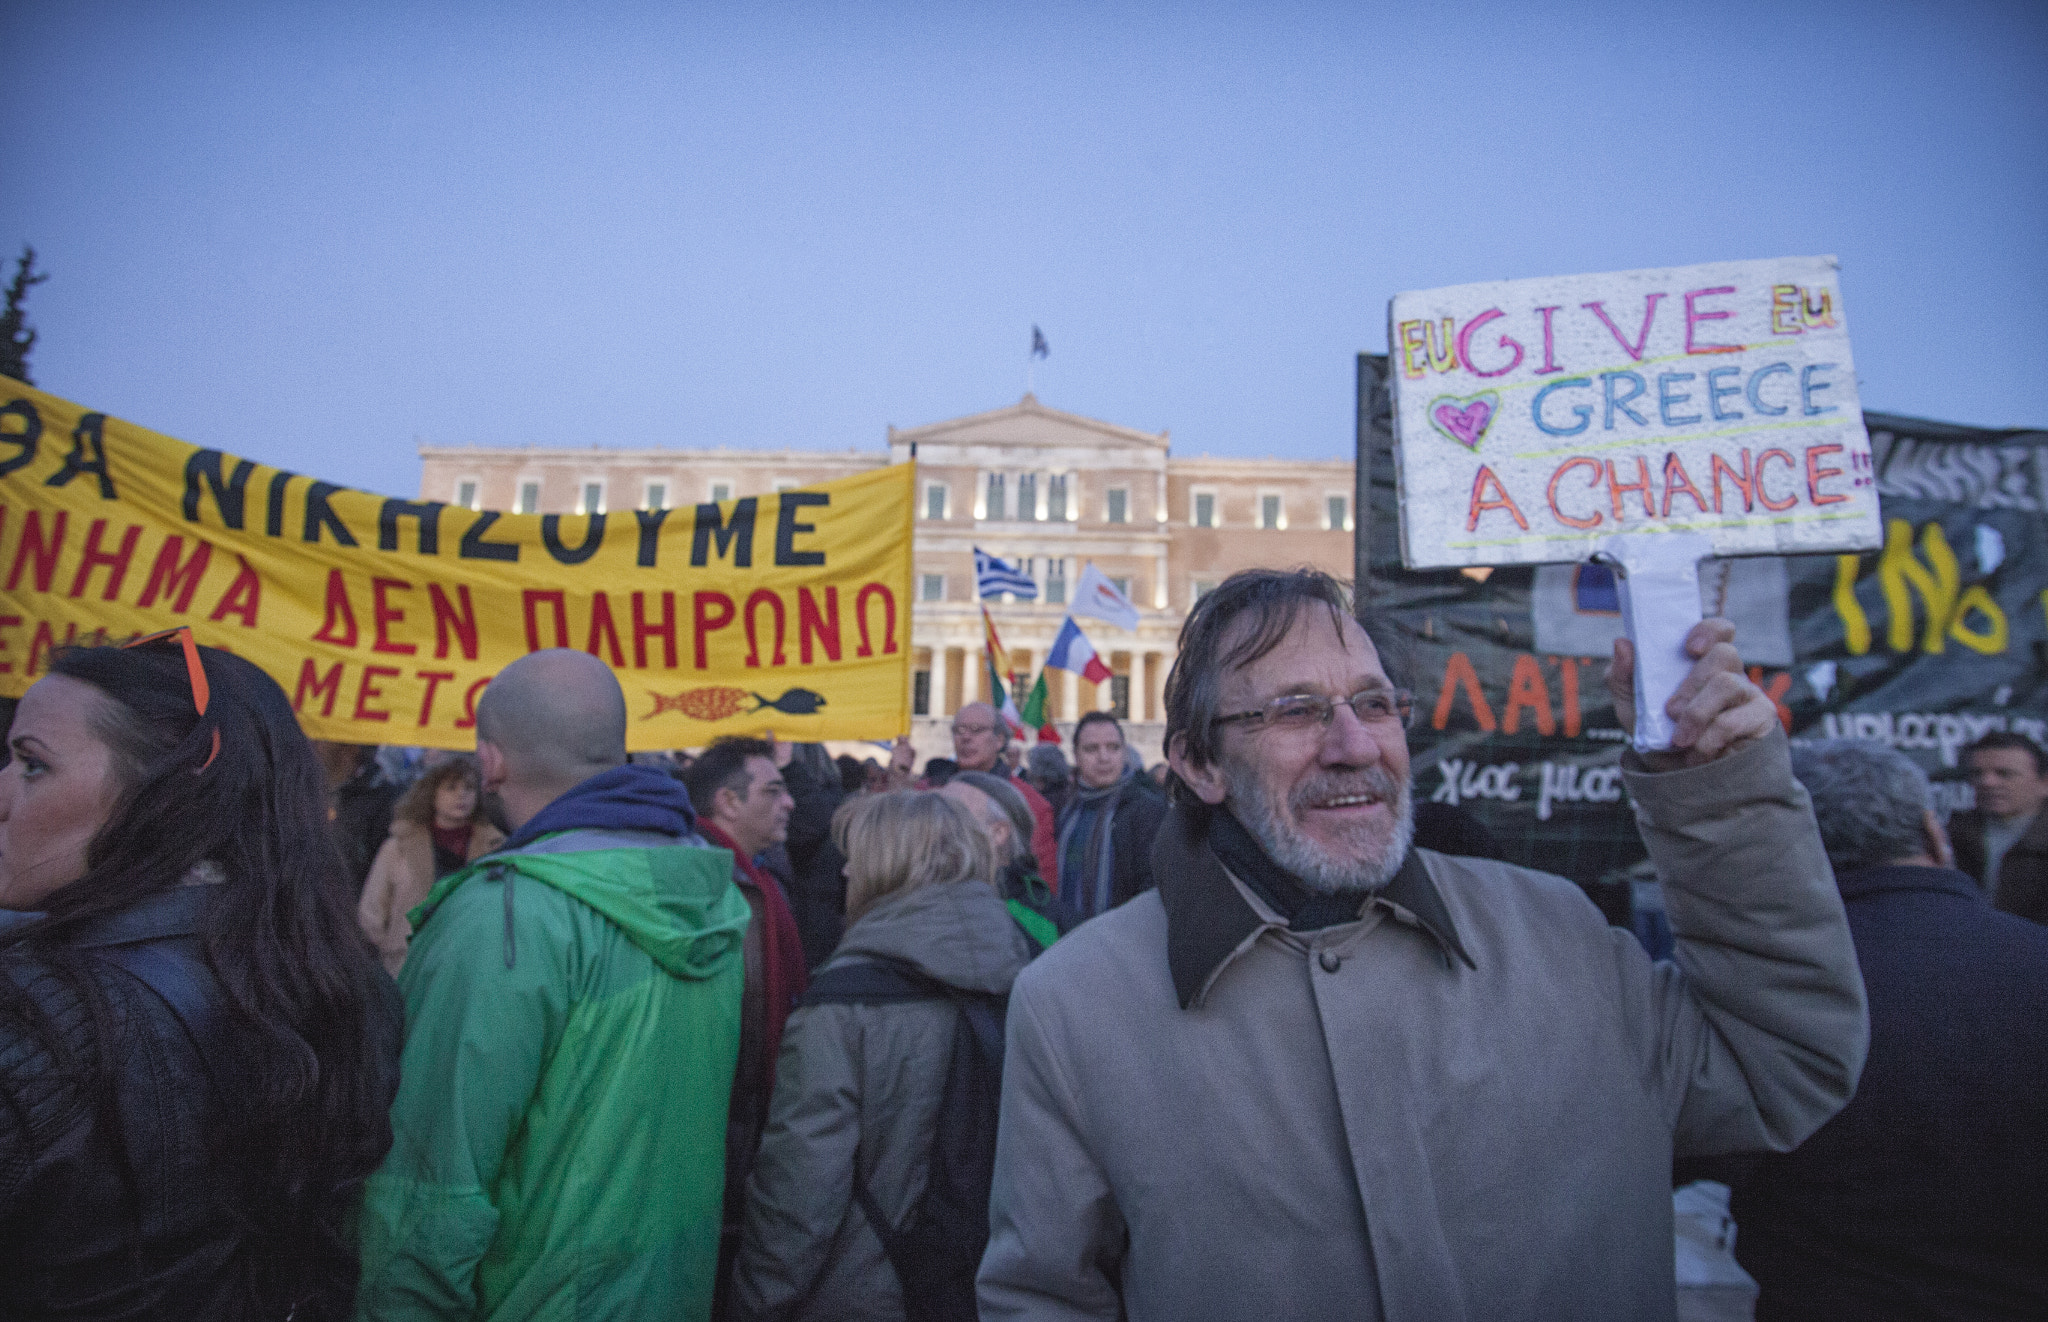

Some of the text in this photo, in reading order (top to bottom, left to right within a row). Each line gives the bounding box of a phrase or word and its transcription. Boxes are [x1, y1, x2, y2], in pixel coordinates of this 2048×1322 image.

[1399, 316, 1459, 380] EU
[1455, 285, 1745, 378] GIVE
[1531, 361, 1839, 436] GREECE
[1466, 462, 1529, 532] A
[0, 503, 262, 629] ΝΗΜΑ
[310, 568, 479, 661] ΔΕΝ
[521, 582, 898, 669] ΠΛΗΡΩΝΩ
